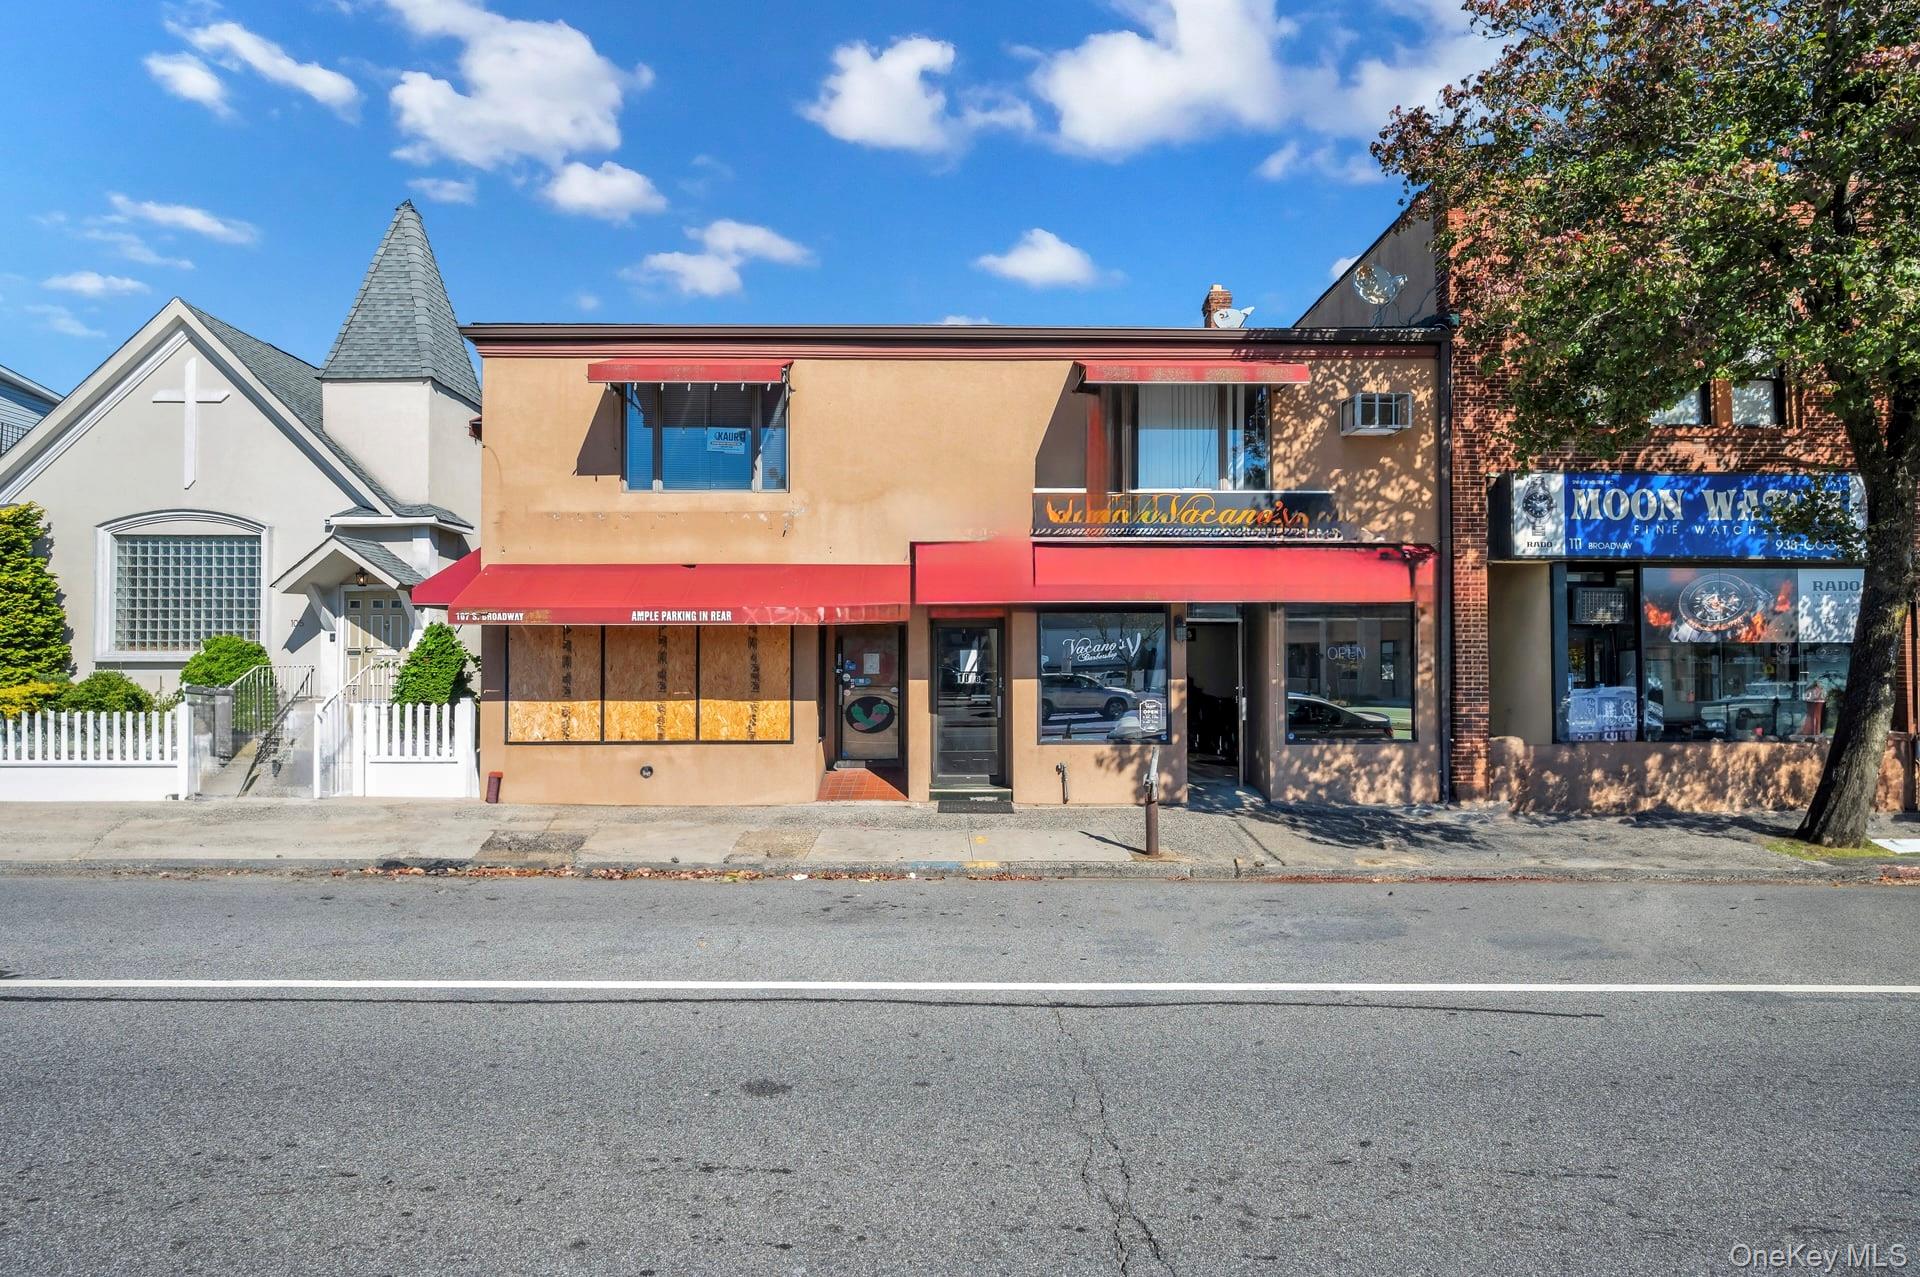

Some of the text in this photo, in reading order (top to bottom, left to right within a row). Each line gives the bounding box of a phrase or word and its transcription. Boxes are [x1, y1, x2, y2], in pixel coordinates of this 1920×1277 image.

[1571, 488, 1684, 521] MOON
[1633, 524, 1678, 535] FINE
[1569, 538, 1632, 550] 111 BROADWAY
[1812, 580, 1860, 592] RADO
[631, 610, 660, 622] AMPLE
[661, 610, 697, 622] PARKING
[699, 610, 708, 622] IN
[710, 610, 732, 622] REAR
[1062, 637, 1128, 656] Vacano's
[1327, 646, 1366, 660] OPEN
